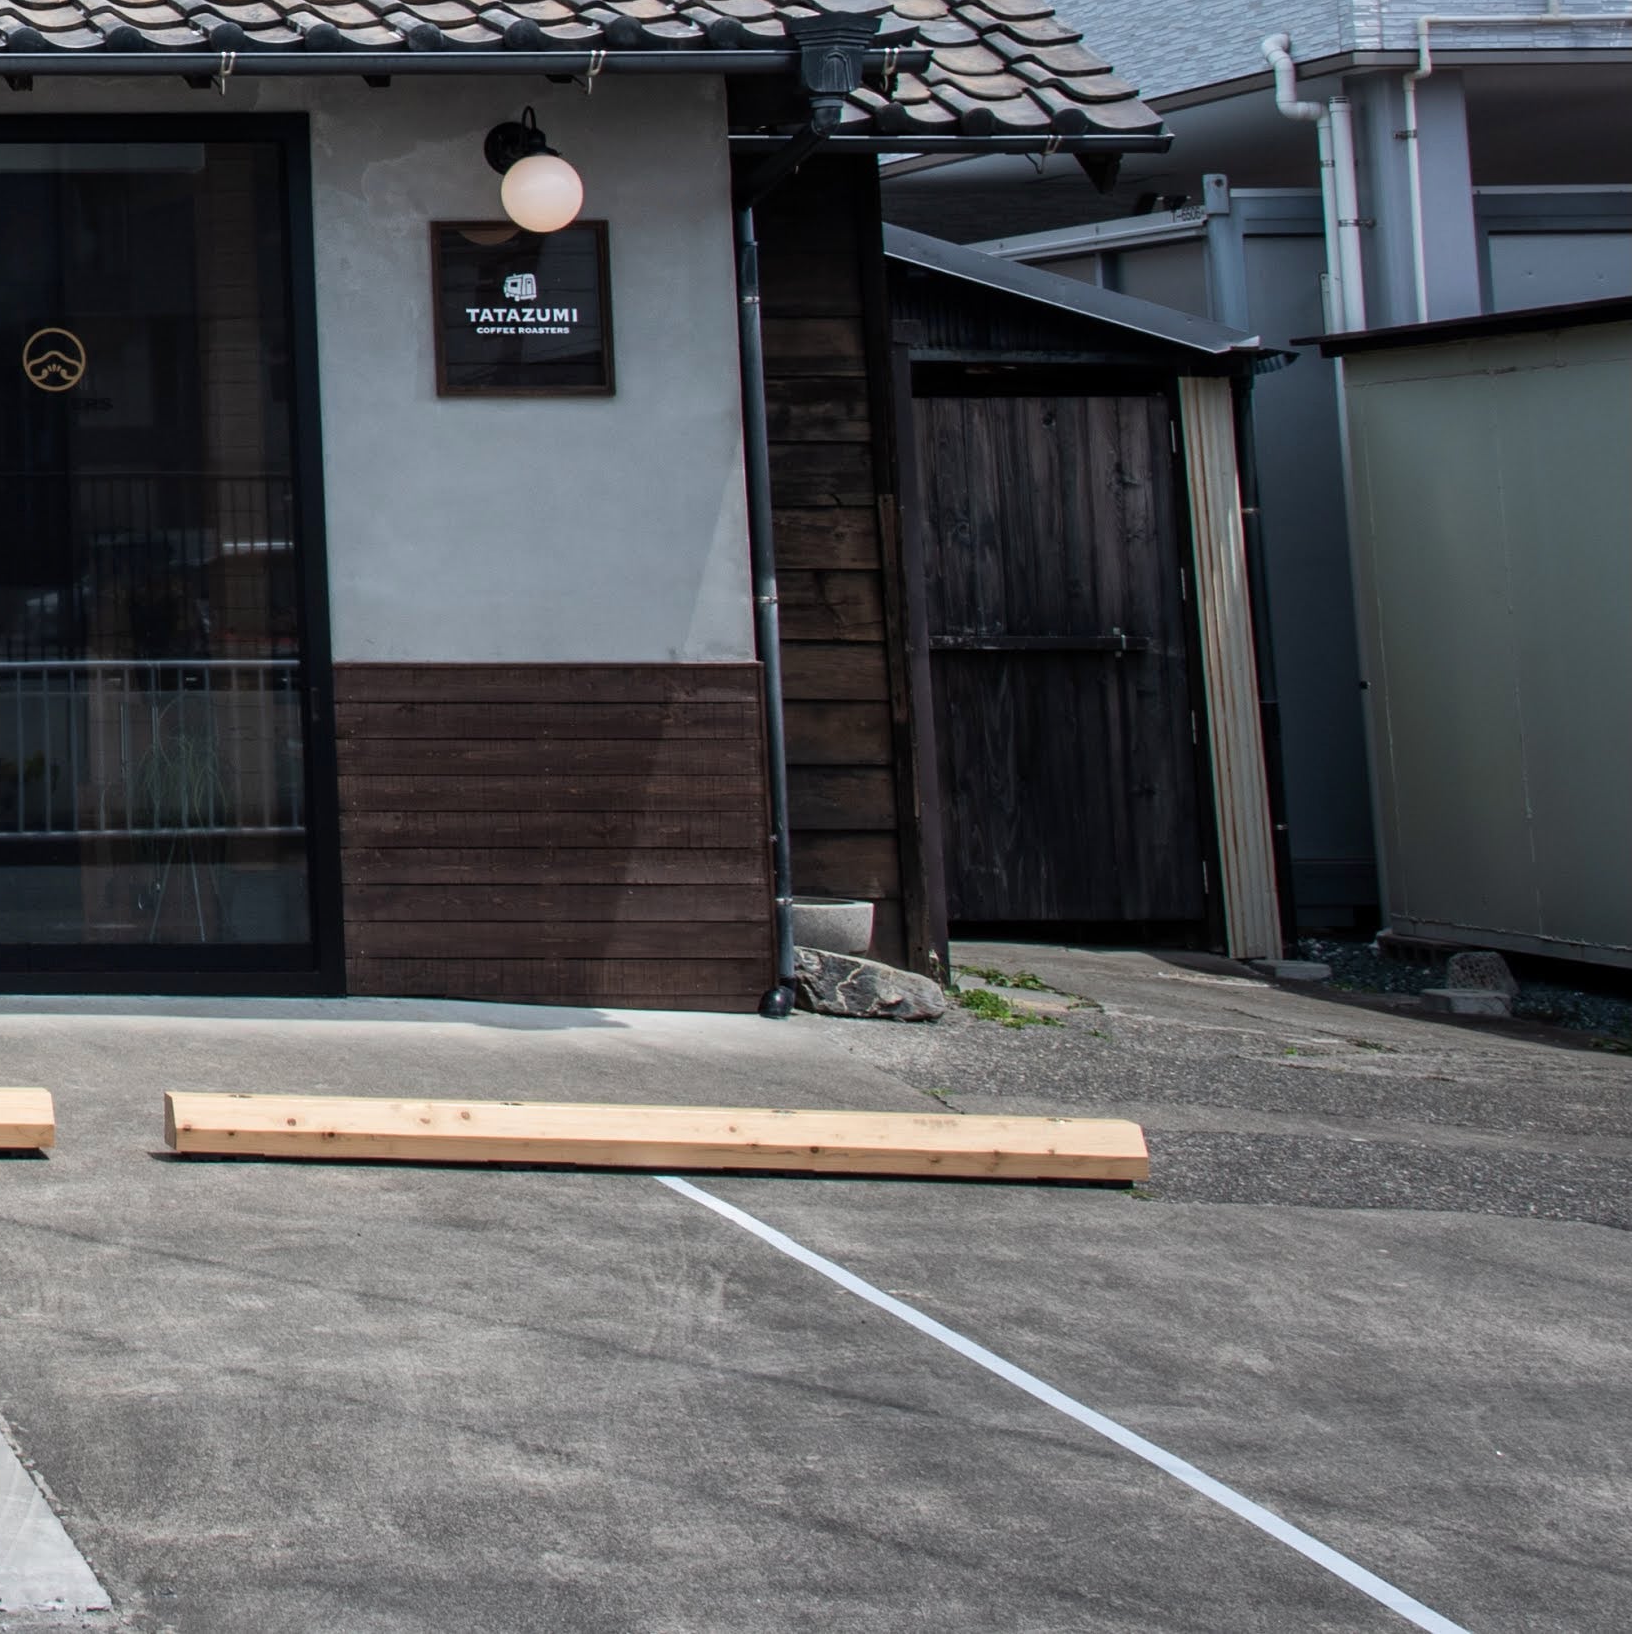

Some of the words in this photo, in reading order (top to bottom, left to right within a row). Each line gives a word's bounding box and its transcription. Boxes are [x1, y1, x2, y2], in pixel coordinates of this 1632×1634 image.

[465, 308, 578, 323] TATAZUMI
[476, 327, 516, 335] COFFEE
[518, 327, 570, 335] ROASTERS
